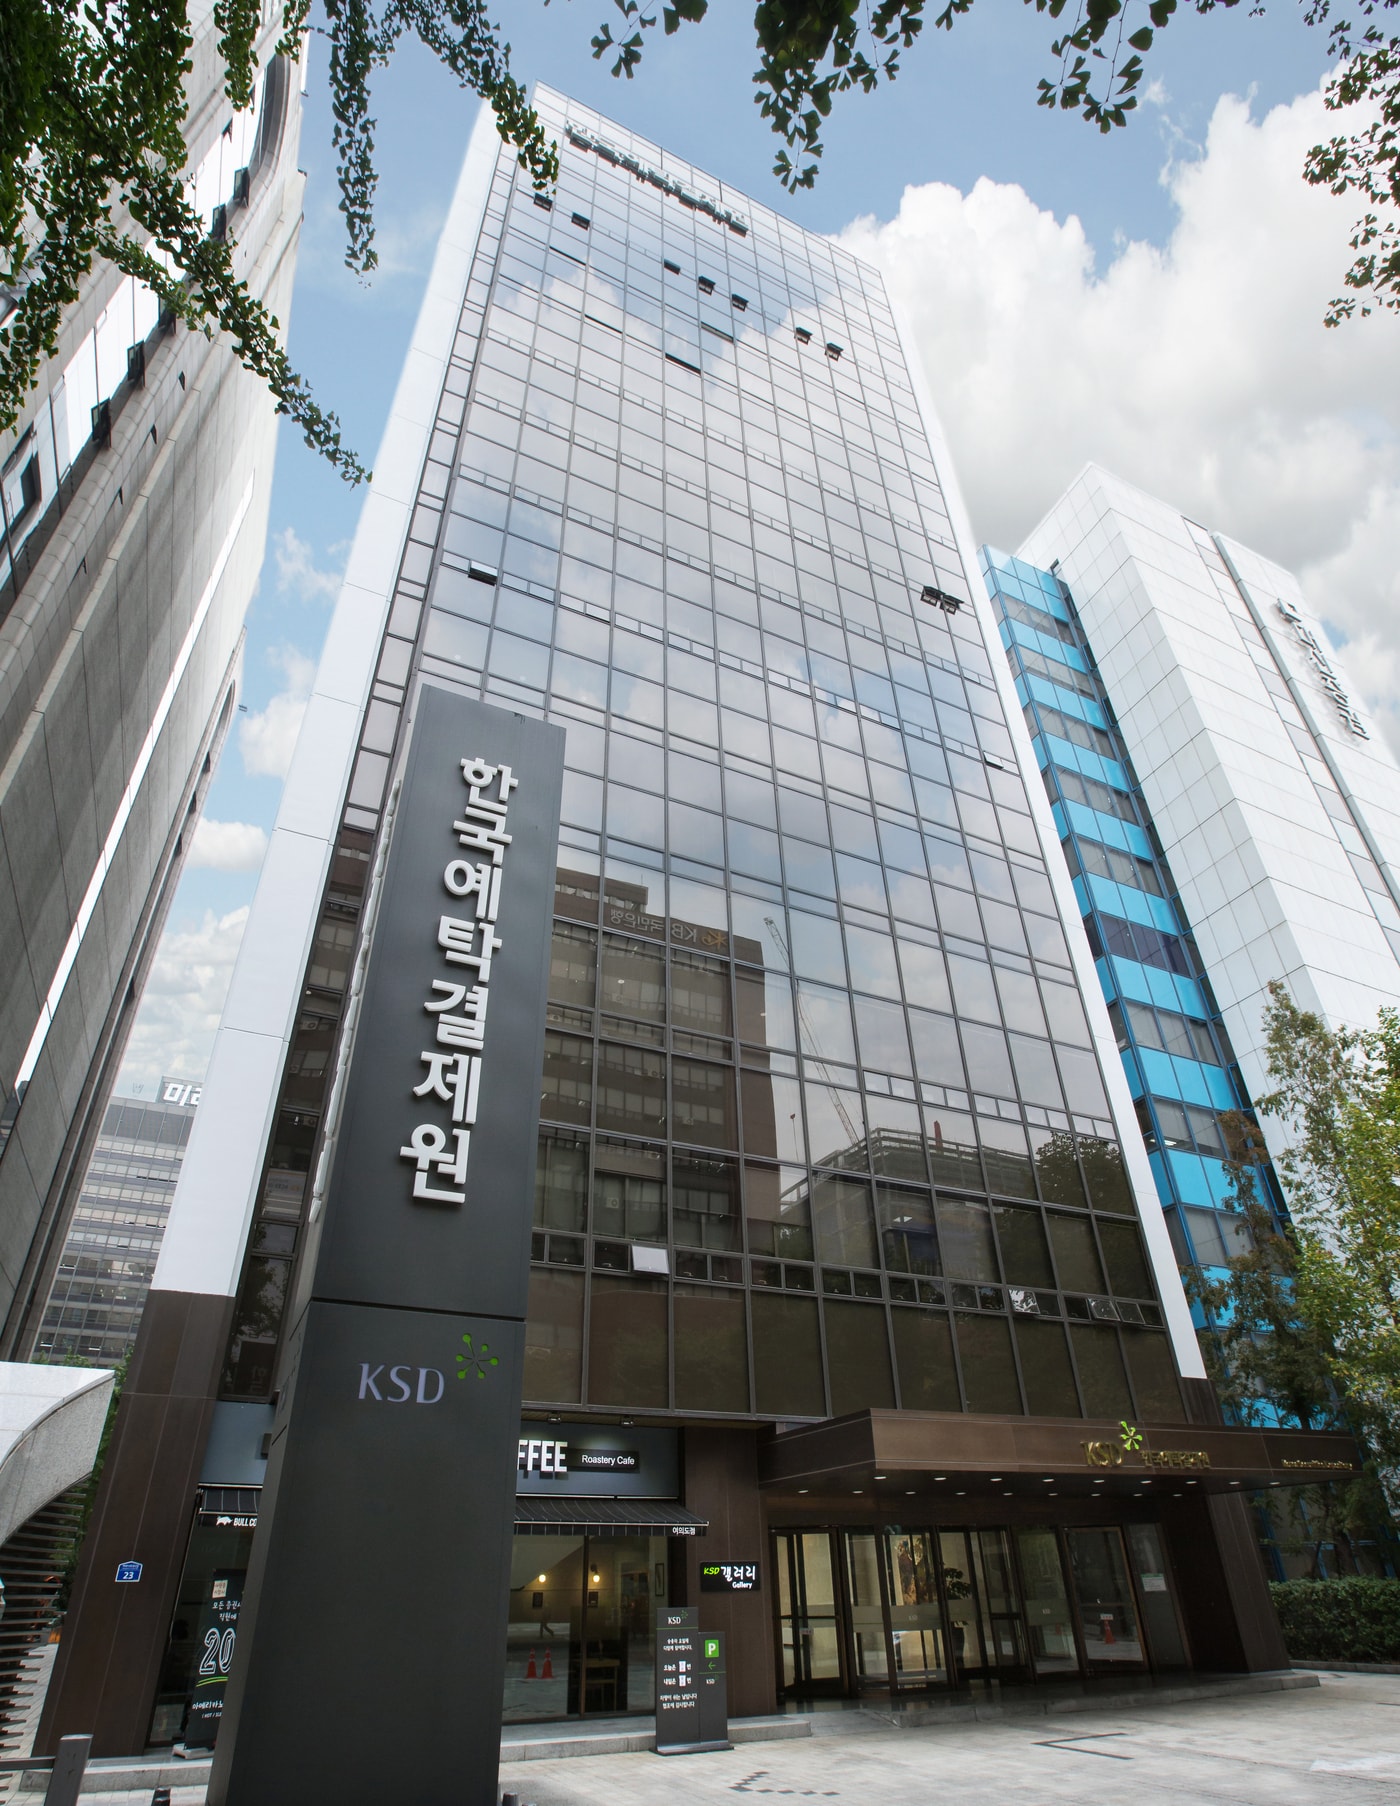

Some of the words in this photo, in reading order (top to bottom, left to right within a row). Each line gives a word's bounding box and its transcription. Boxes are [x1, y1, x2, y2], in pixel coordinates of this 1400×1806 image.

[400, 757, 518, 1204] 한국예탁결제원
[358, 1362, 445, 1404] KSD
[517, 1439, 568, 1472] FFEE
[581, 1454, 616, 1467] Roastery
[617, 1455, 635, 1465] Cafe
[1081, 1441, 1124, 1467] KSD
[233, 1517, 249, 1527] BULL
[672, 1526, 696, 1536] 여의도점
[122, 1571, 134, 1580] 23
[703, 1566, 720, 1575] KSD
[720, 1565, 756, 1582] 갤러리
[732, 1581, 753, 1589] Gallery
[211, 1600, 225, 1610] 모든
[667, 1616, 682, 1625] KSD
[199, 1627, 236, 1675] 20
[708, 1642, 717, 1656] P
